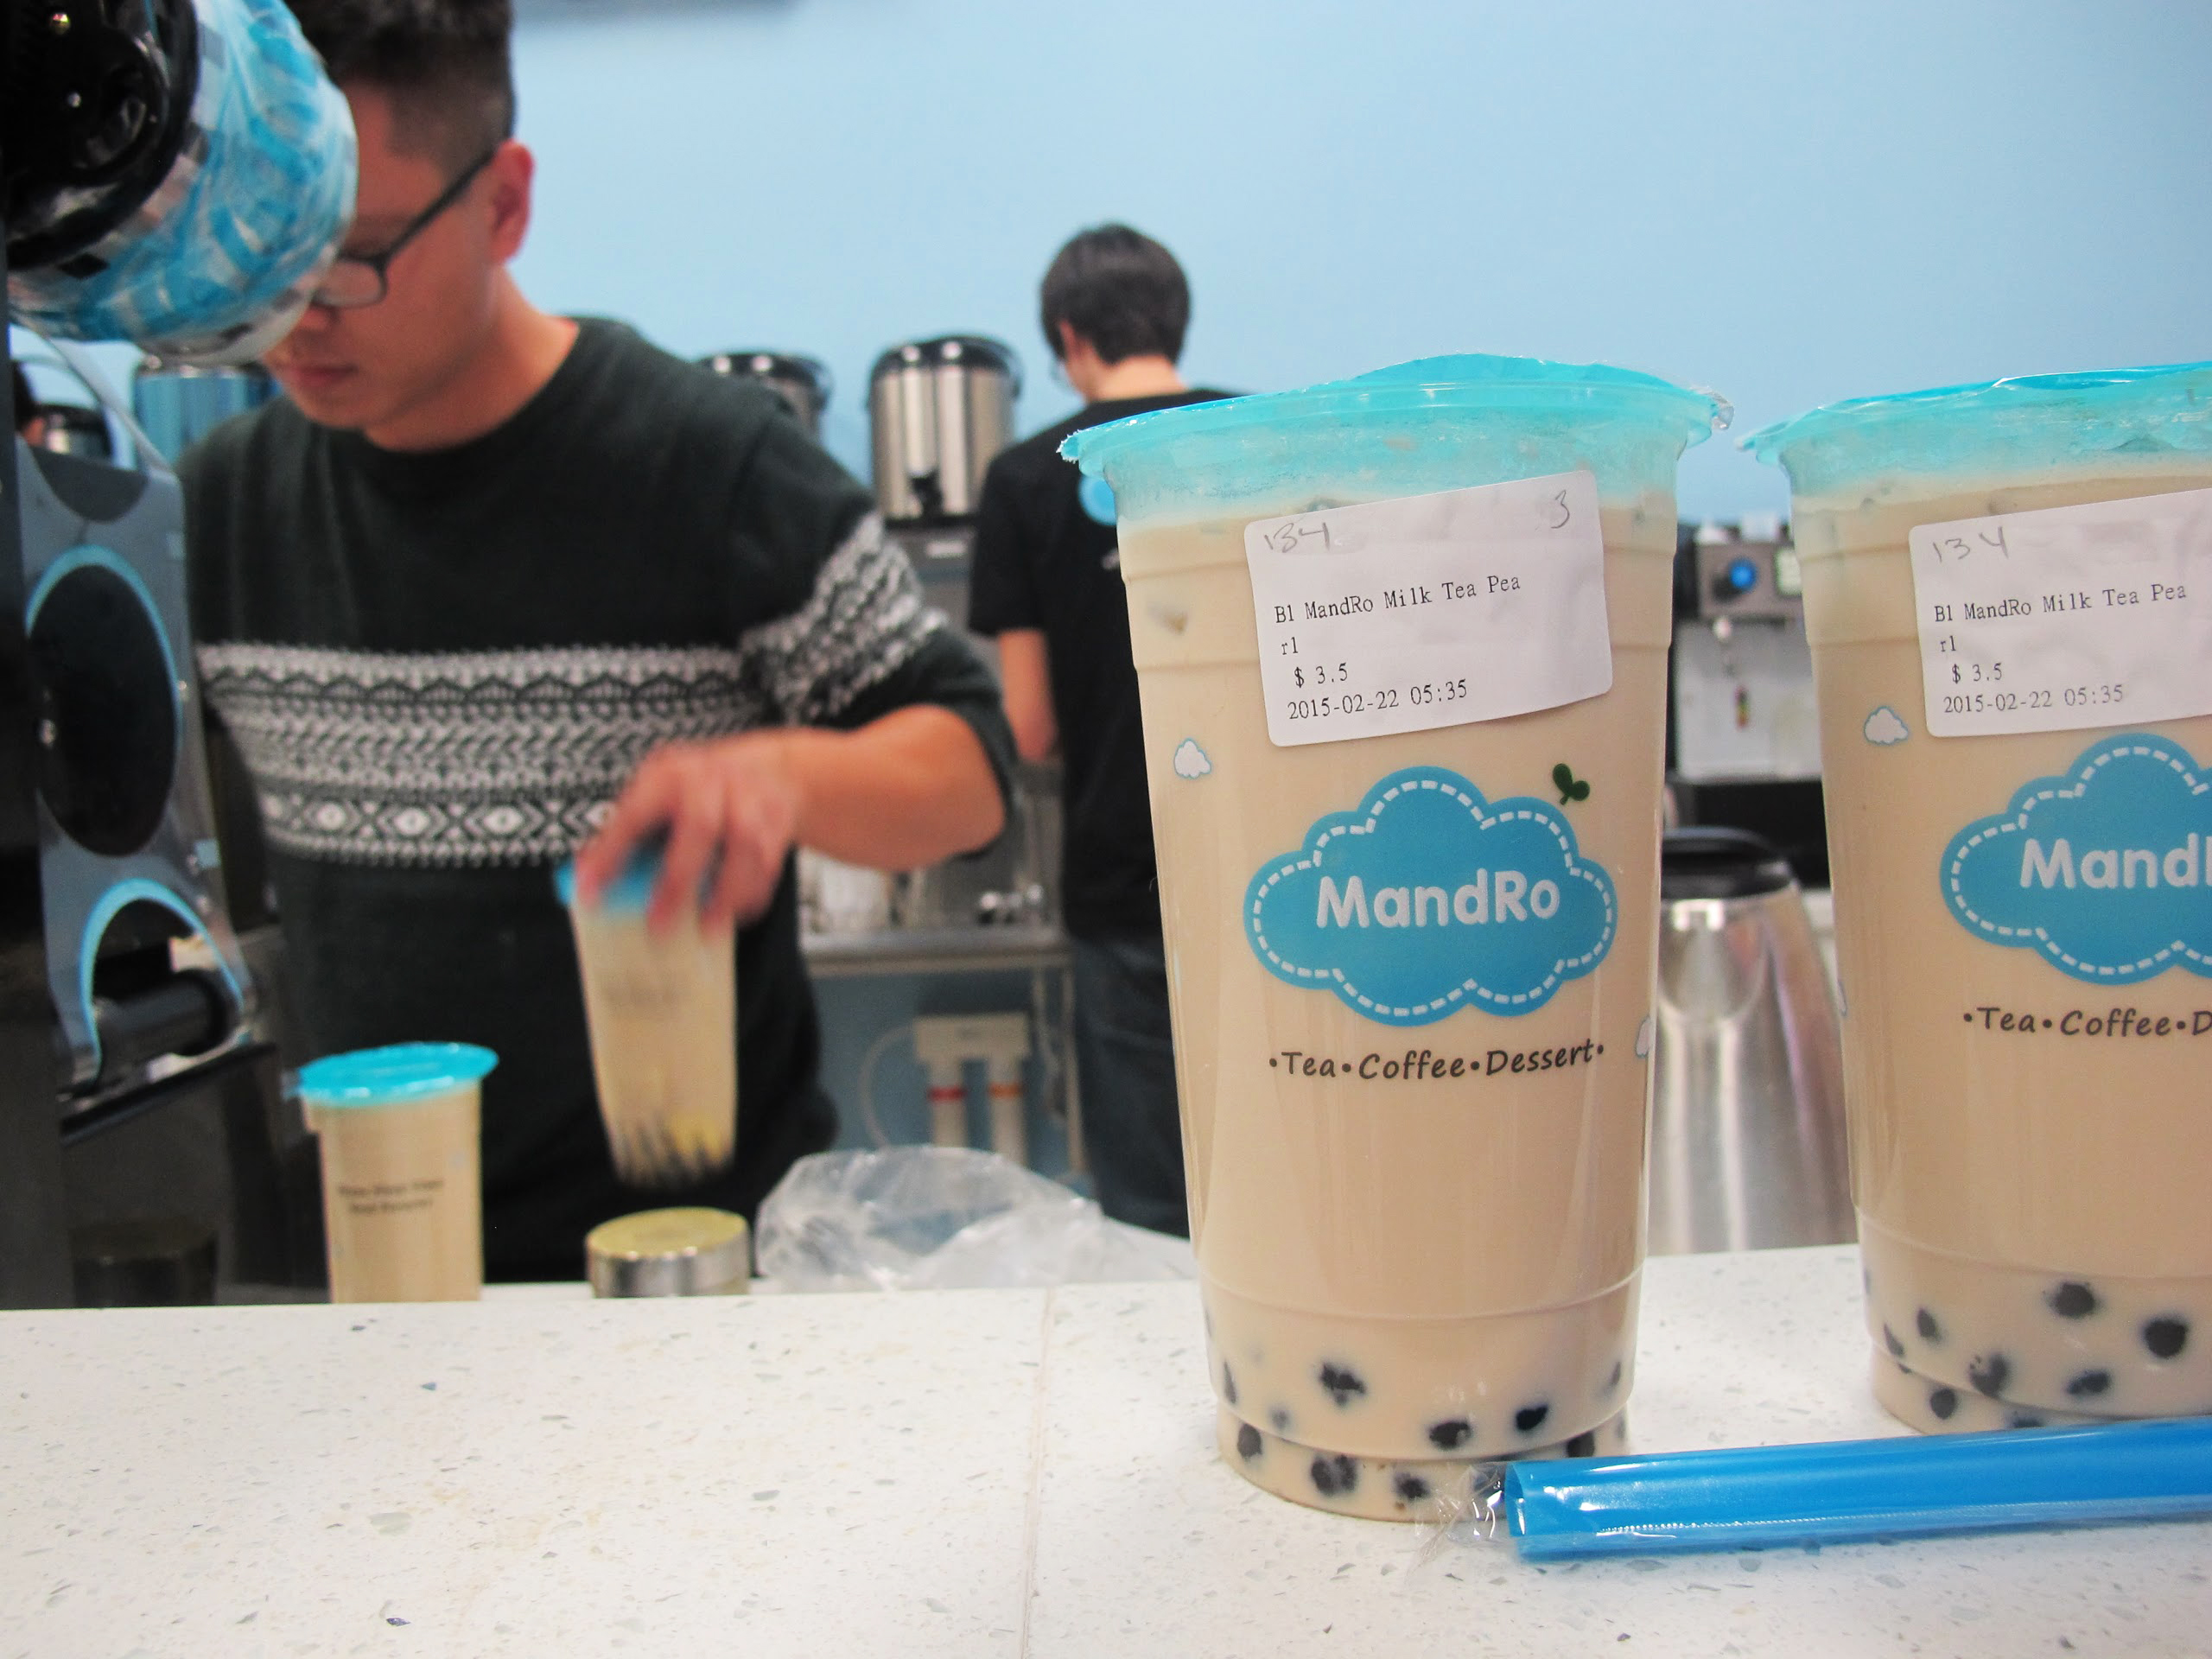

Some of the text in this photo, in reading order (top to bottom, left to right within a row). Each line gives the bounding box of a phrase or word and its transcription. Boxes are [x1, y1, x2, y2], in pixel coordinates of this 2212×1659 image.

[1551, 489, 1571, 529] 3
[1932, 525, 2009, 564] 134
[1305, 594, 1374, 620] MandRo
[1384, 586, 1433, 610] Milk
[1442, 581, 1477, 601] Tea
[1487, 575, 1521, 594] Pea
[1964, 599, 2031, 620] MandRo
[2043, 592, 2092, 613] Milk
[2102, 588, 2139, 607] Tea
[2151, 583, 2187, 602] Pea
[1287, 678, 1468, 721] 2015-02-22 05:35
[1944, 684, 2124, 715] 2015-02-22 05:35
[2019, 832, 2212, 889] Mand
[1316, 868, 1560, 929] MandRo
